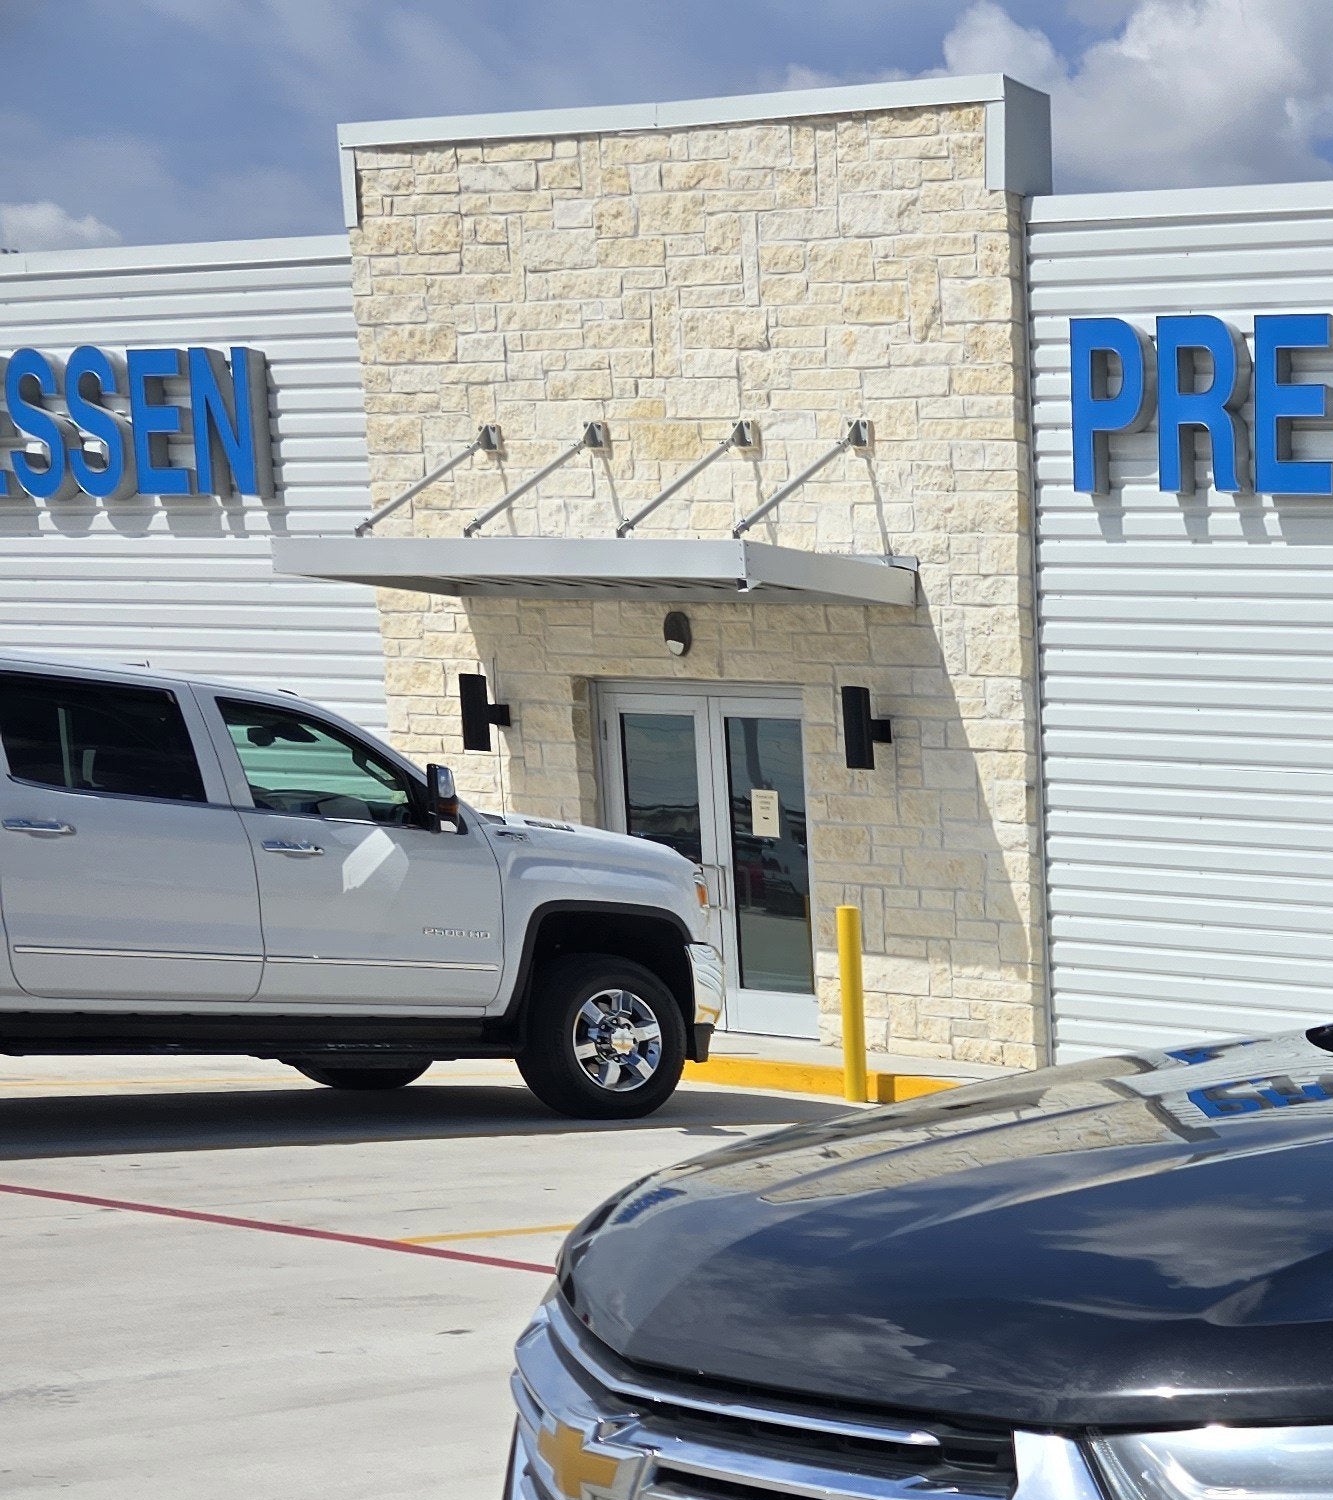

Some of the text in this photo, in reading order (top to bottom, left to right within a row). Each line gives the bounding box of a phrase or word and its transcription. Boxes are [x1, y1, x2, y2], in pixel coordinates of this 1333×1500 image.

[0, 345, 262, 499] SSEN
[423, 927, 490, 939] 2500 HD
